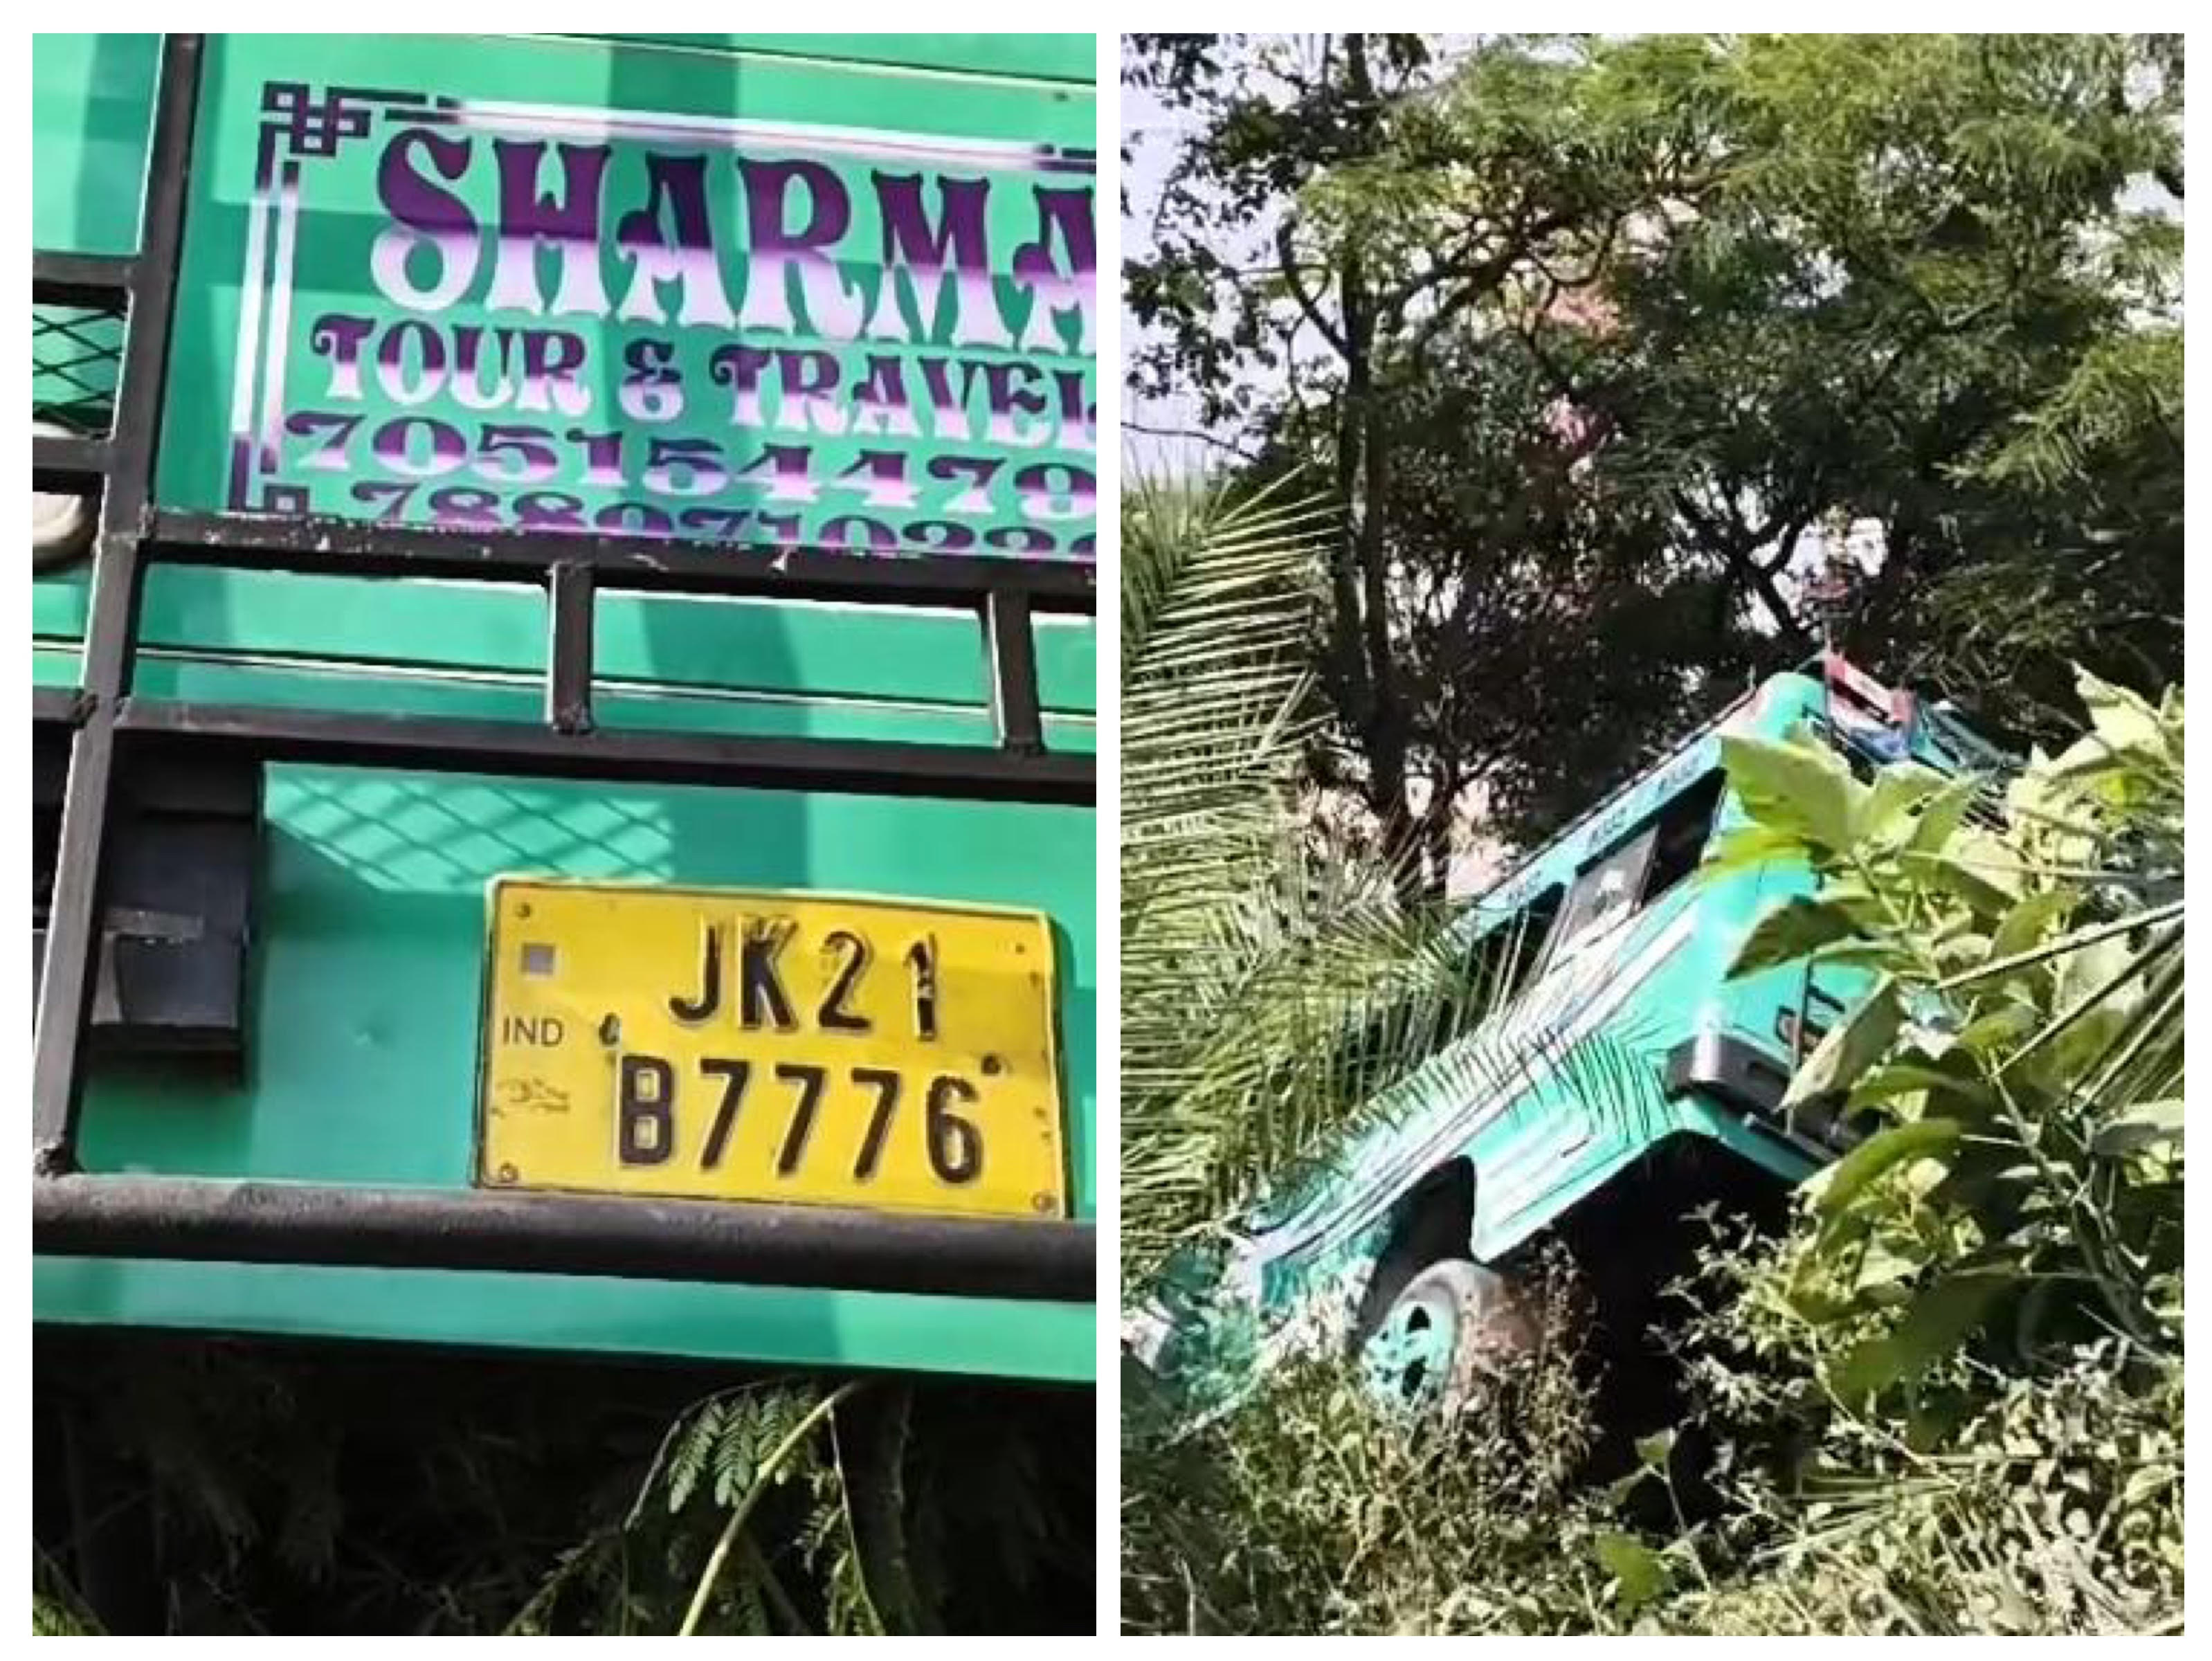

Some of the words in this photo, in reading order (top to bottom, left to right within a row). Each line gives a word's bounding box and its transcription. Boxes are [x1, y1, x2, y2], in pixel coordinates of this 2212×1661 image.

[370, 127, 1096, 355] SHARMA
[311, 313, 592, 415] TOUR
[619, 338, 685, 423] &
[709, 342, 1096, 451] TRAVEL
[502, 1015, 565, 1048] IND
[669, 915, 940, 1042] JK21
[618, 1052, 984, 1185] B7776
